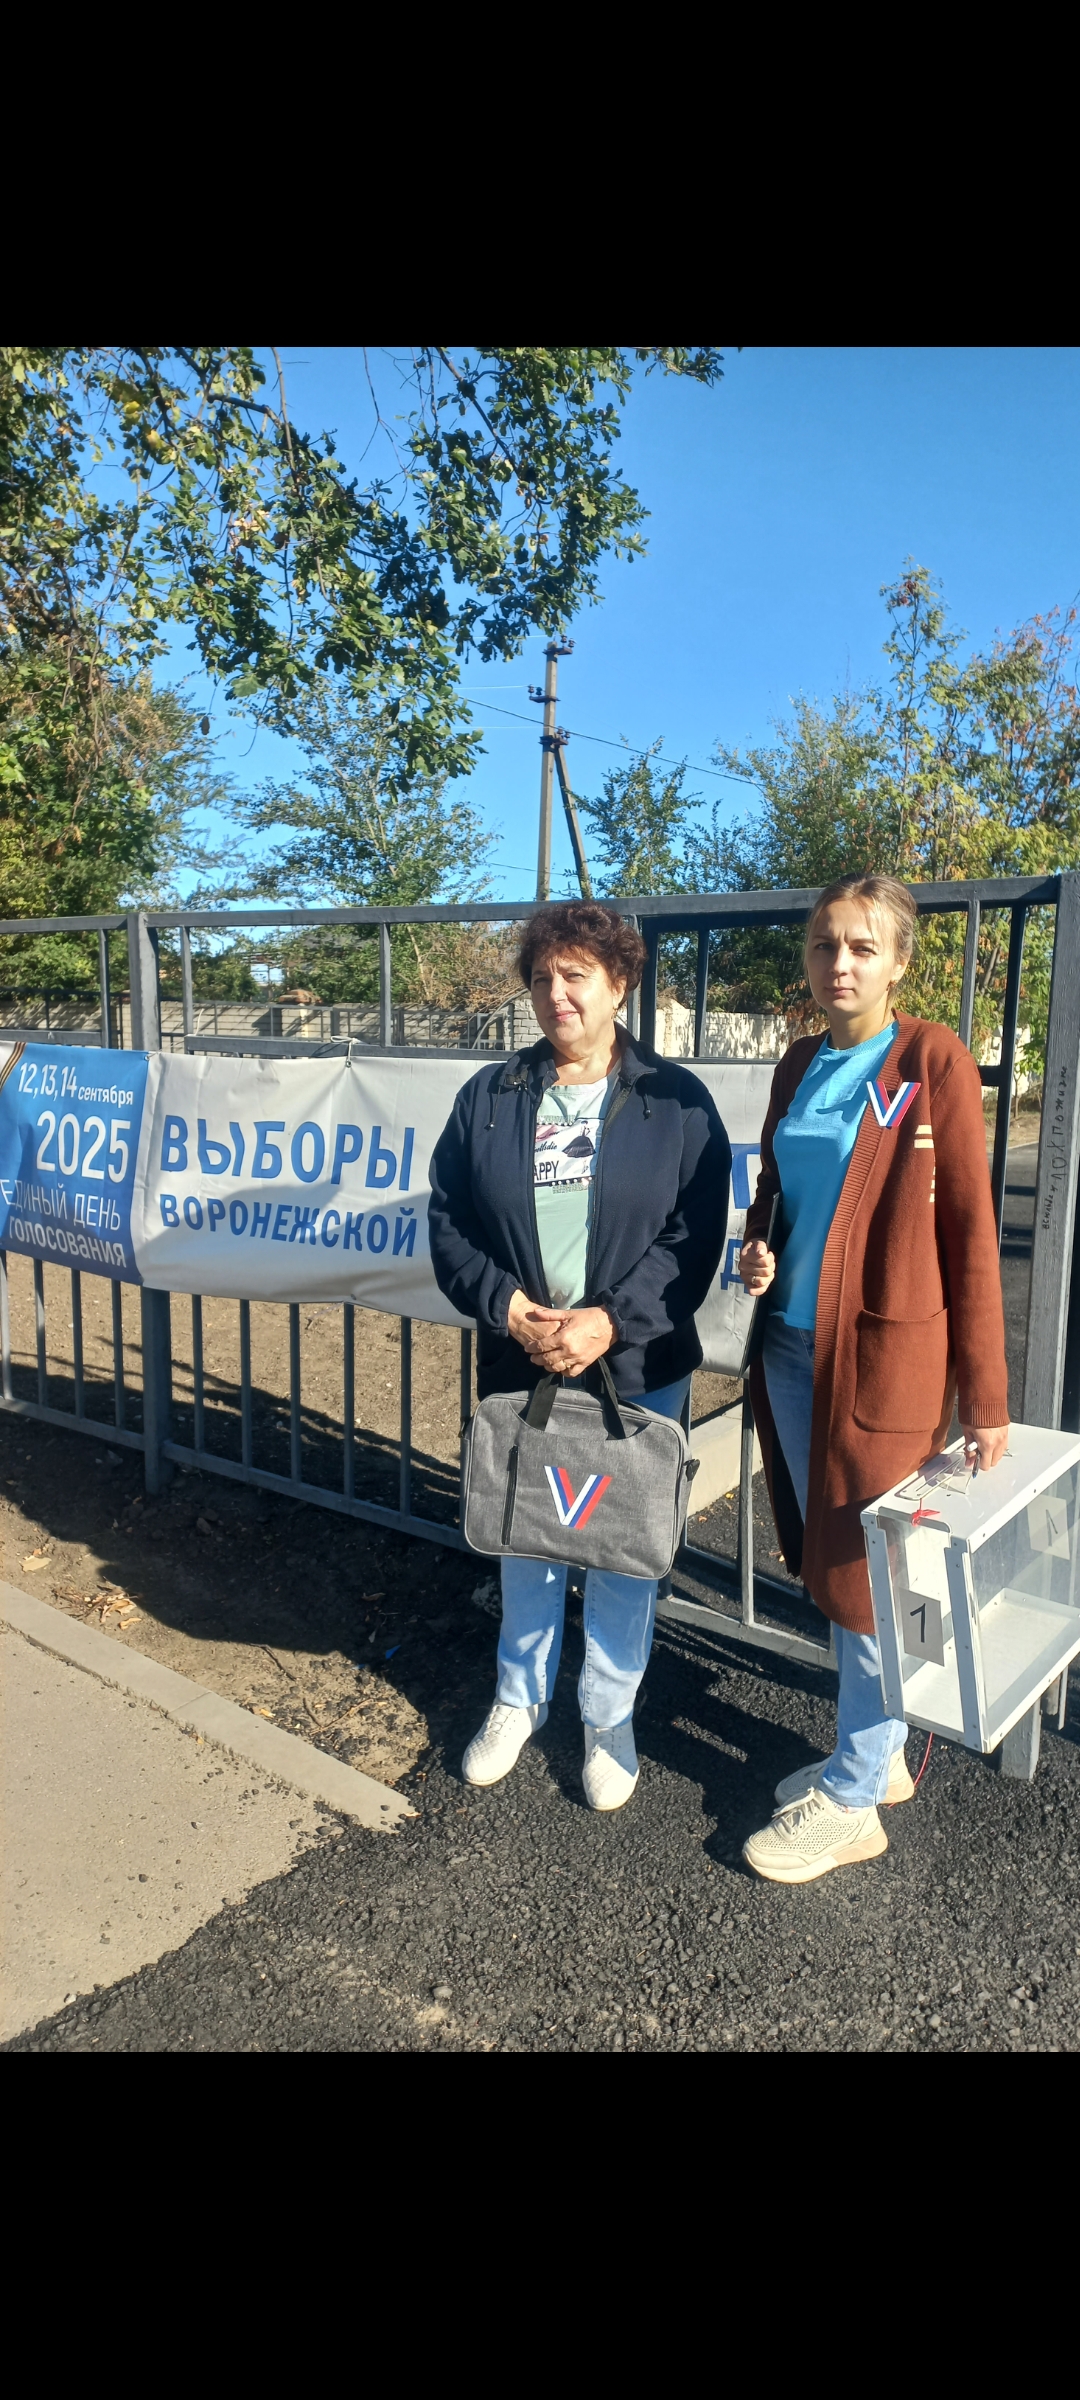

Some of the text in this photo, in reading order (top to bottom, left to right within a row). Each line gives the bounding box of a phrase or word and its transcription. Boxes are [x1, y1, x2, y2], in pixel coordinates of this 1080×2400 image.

[18, 1062, 133, 1108] 12,13,14 сентября
[36, 1110, 131, 1183] 2025
[160, 1114, 415, 1191] ВЫБОРЫ
[0, 1179, 121, 1231] ЕДИНЫЙ ДЕНЬ
[160, 1193, 417, 1257] ВОРОНЕЖСКОЙ
[9, 1215, 127, 1268] голосования
[910, 1603, 927, 1643] 1
